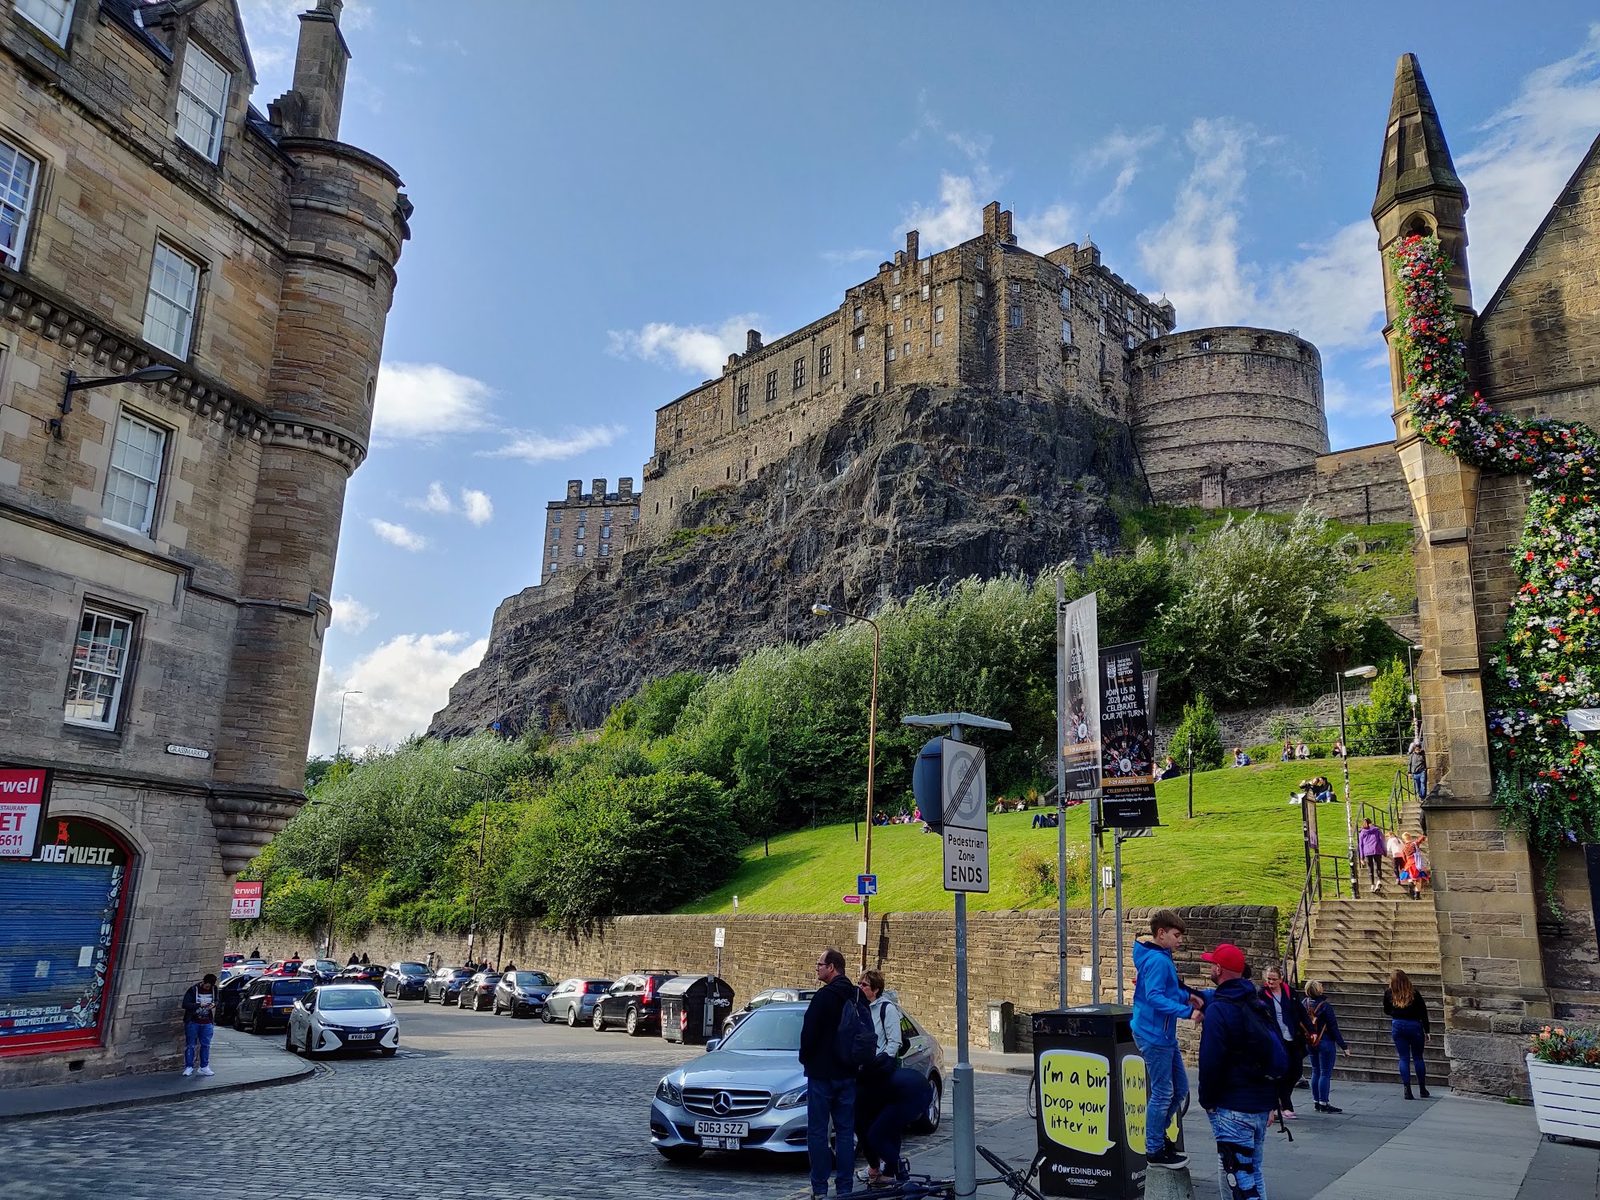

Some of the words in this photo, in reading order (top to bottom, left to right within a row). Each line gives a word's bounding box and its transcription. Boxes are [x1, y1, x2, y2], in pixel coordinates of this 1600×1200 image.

[1105, 689, 1119, 698] JOIN
[1120, 687, 1128, 695] US
[1129, 685, 1136, 693] IN
[1121, 694, 1135, 702] AND
[1106, 701, 1137, 712] CELEBRATE
[1101, 713, 1116, 721] OUR
[1127, 709, 1144, 718] TURN
[948, 834, 984, 848] Pedestrian
[958, 850, 975, 861] Zone
[952, 865, 982, 883] ENDS
[234, 886, 261, 895] erwell
[237, 899, 256, 908] LET
[1043, 1060, 1063, 1085] I'm
[1070, 1071, 1080, 1085] a
[1086, 1067, 1107, 1088] bin
[1044, 1093, 1073, 1112] Drop
[1078, 1101, 1106, 1116] your
[698, 1122, 721, 1133] SD63
[724, 1123, 743, 1134] SZZ
[1051, 1113, 1083, 1133] litter
[1088, 1118, 1098, 1135] in
